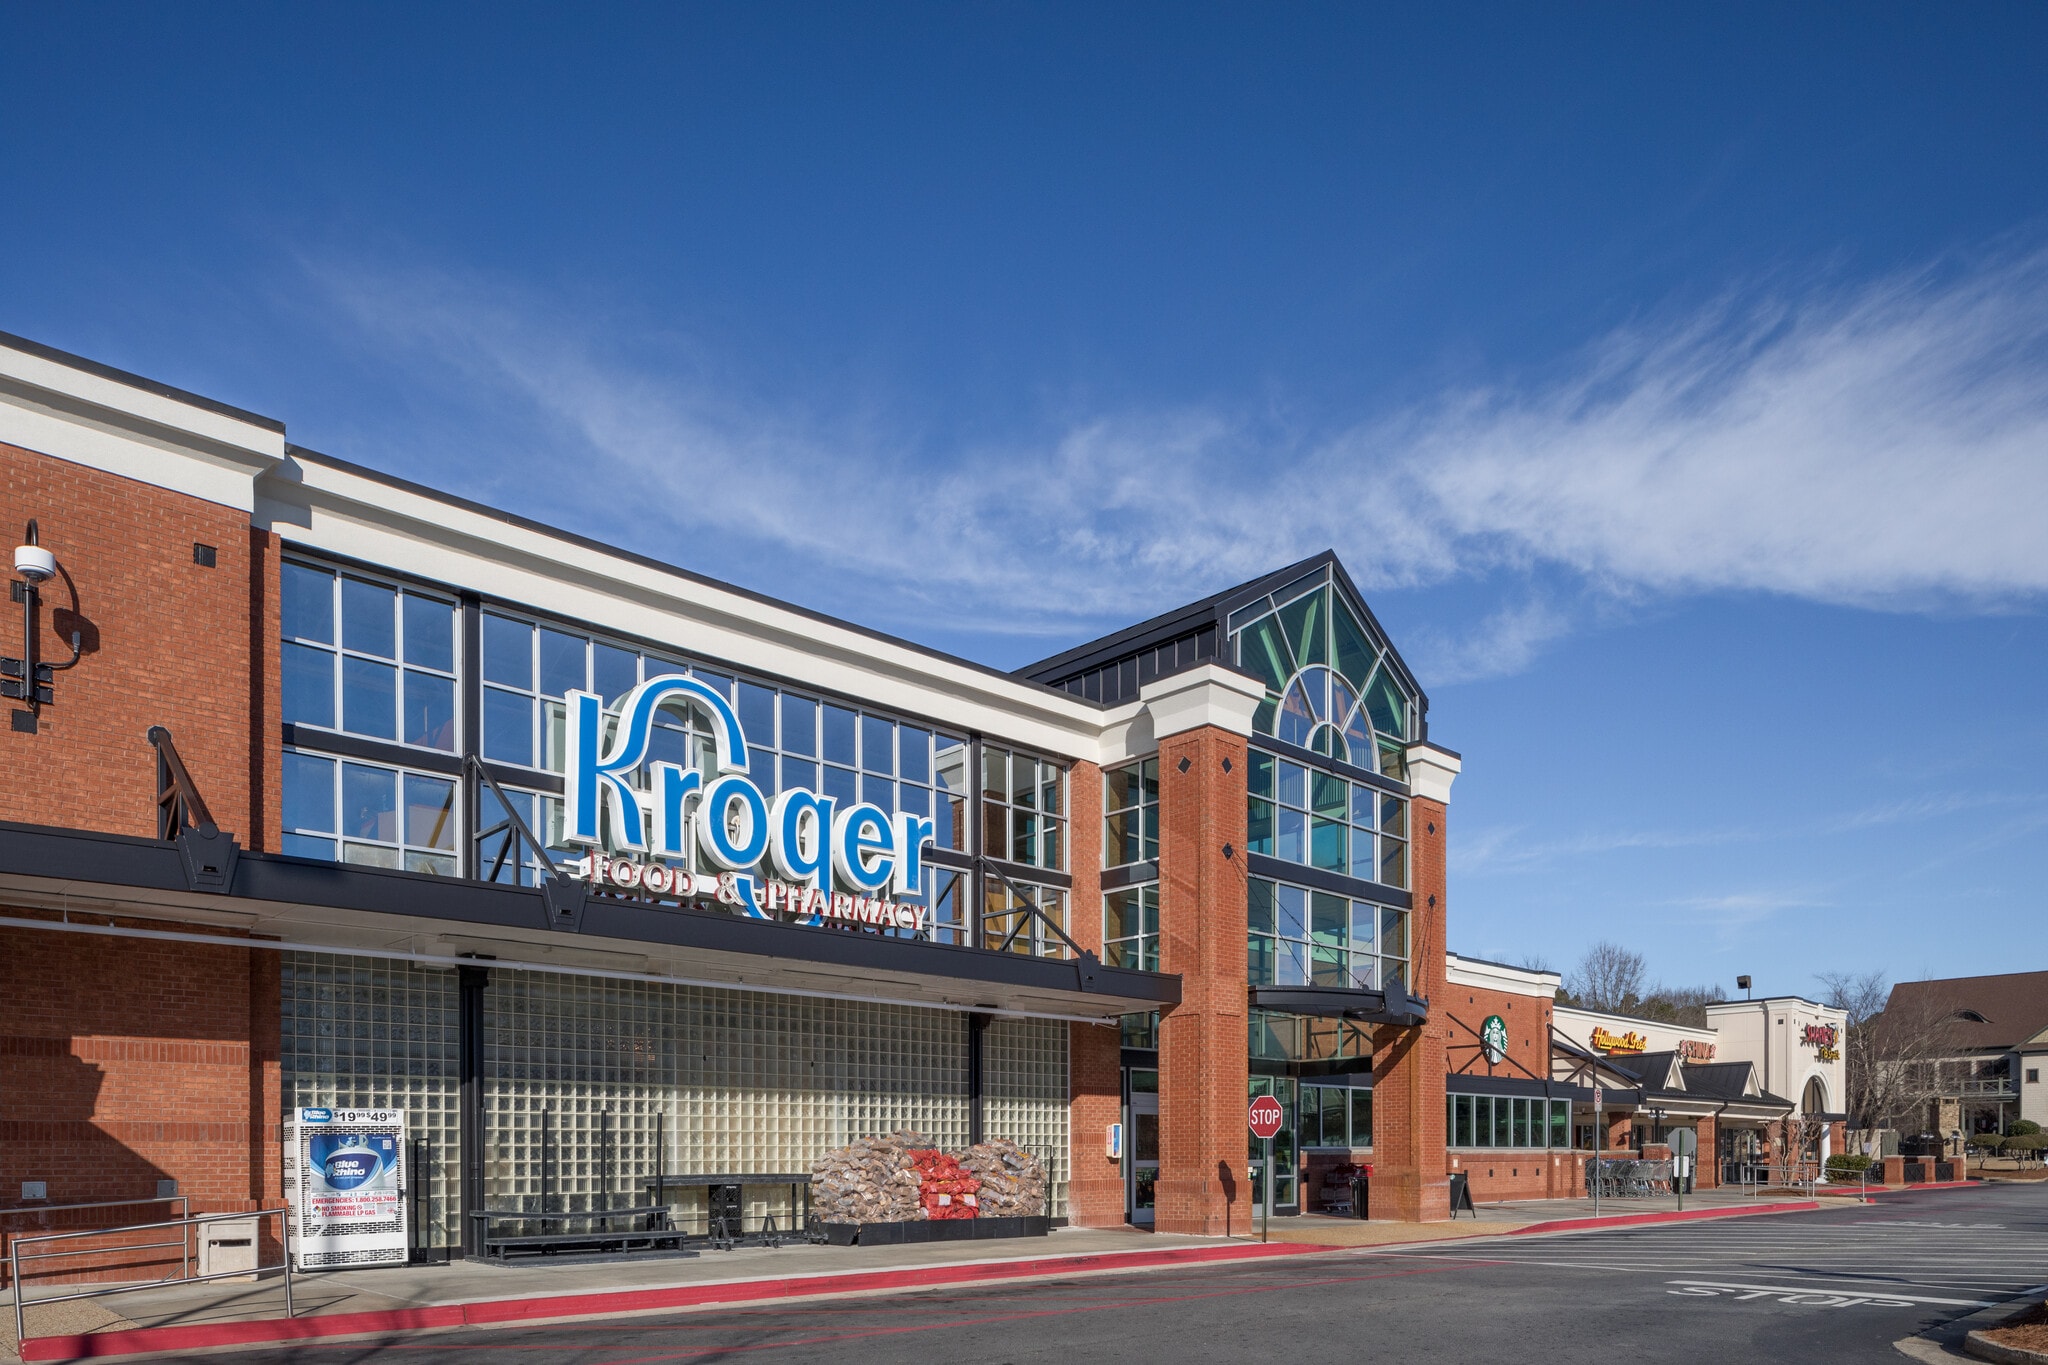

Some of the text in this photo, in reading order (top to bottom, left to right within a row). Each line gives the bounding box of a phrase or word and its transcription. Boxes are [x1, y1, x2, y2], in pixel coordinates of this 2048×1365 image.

[562, 673, 933, 927] Kroger
[589, 850, 927, 932] FOOD & PHARMACY
[1592, 1026, 1629, 1049] Hollywood
[1251, 1109, 1280, 1125] STOP
[335, 1160, 359, 1168] Blue
[1666, 1287, 1915, 1308] STOP
